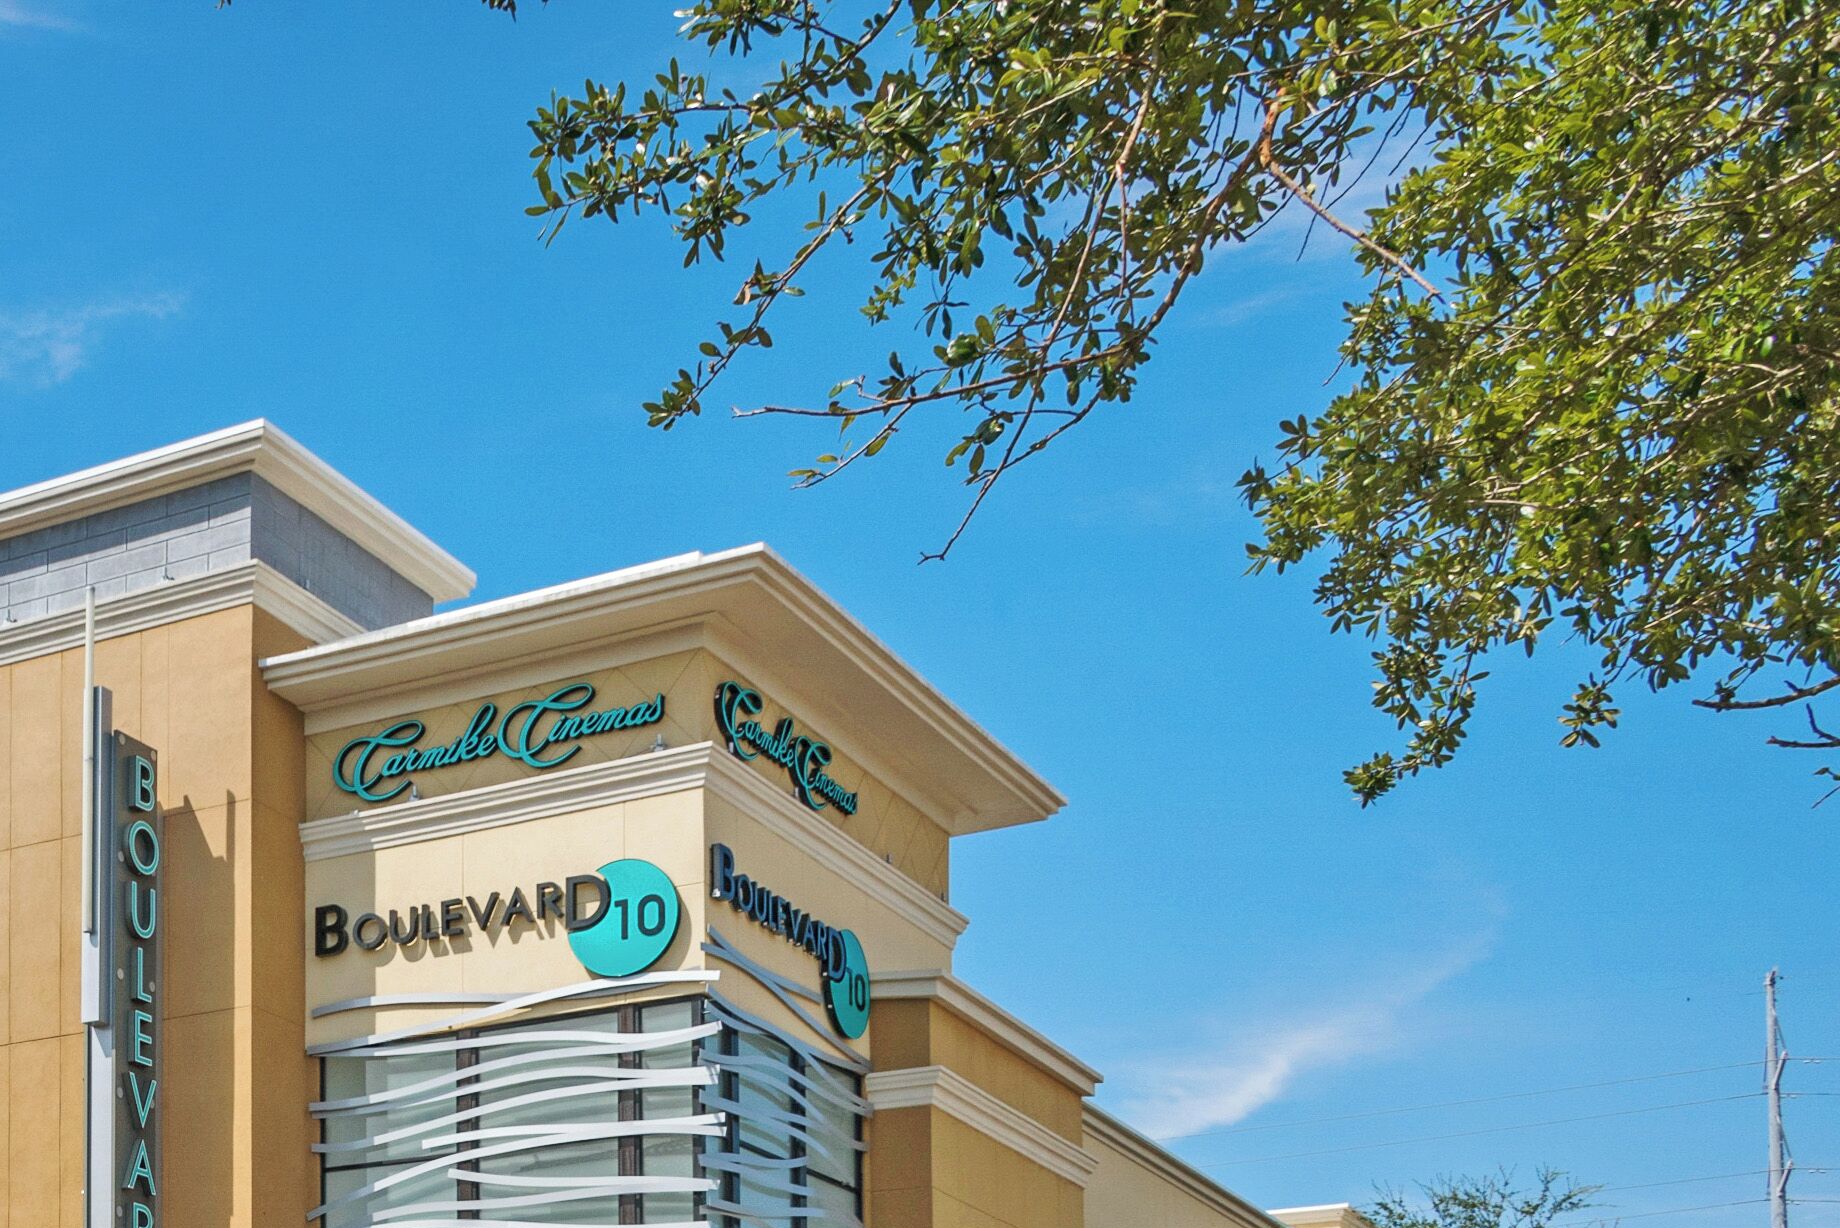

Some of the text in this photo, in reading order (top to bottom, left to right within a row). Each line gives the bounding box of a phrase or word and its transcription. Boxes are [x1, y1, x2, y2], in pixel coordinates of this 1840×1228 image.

[333, 681, 666, 801] Carmike Cinemas
[714, 680, 858, 817] Carmike Cinemas
[314, 873, 666, 958] BOULEVARD 10
[711, 842, 866, 1013] BOULEVARD 10
